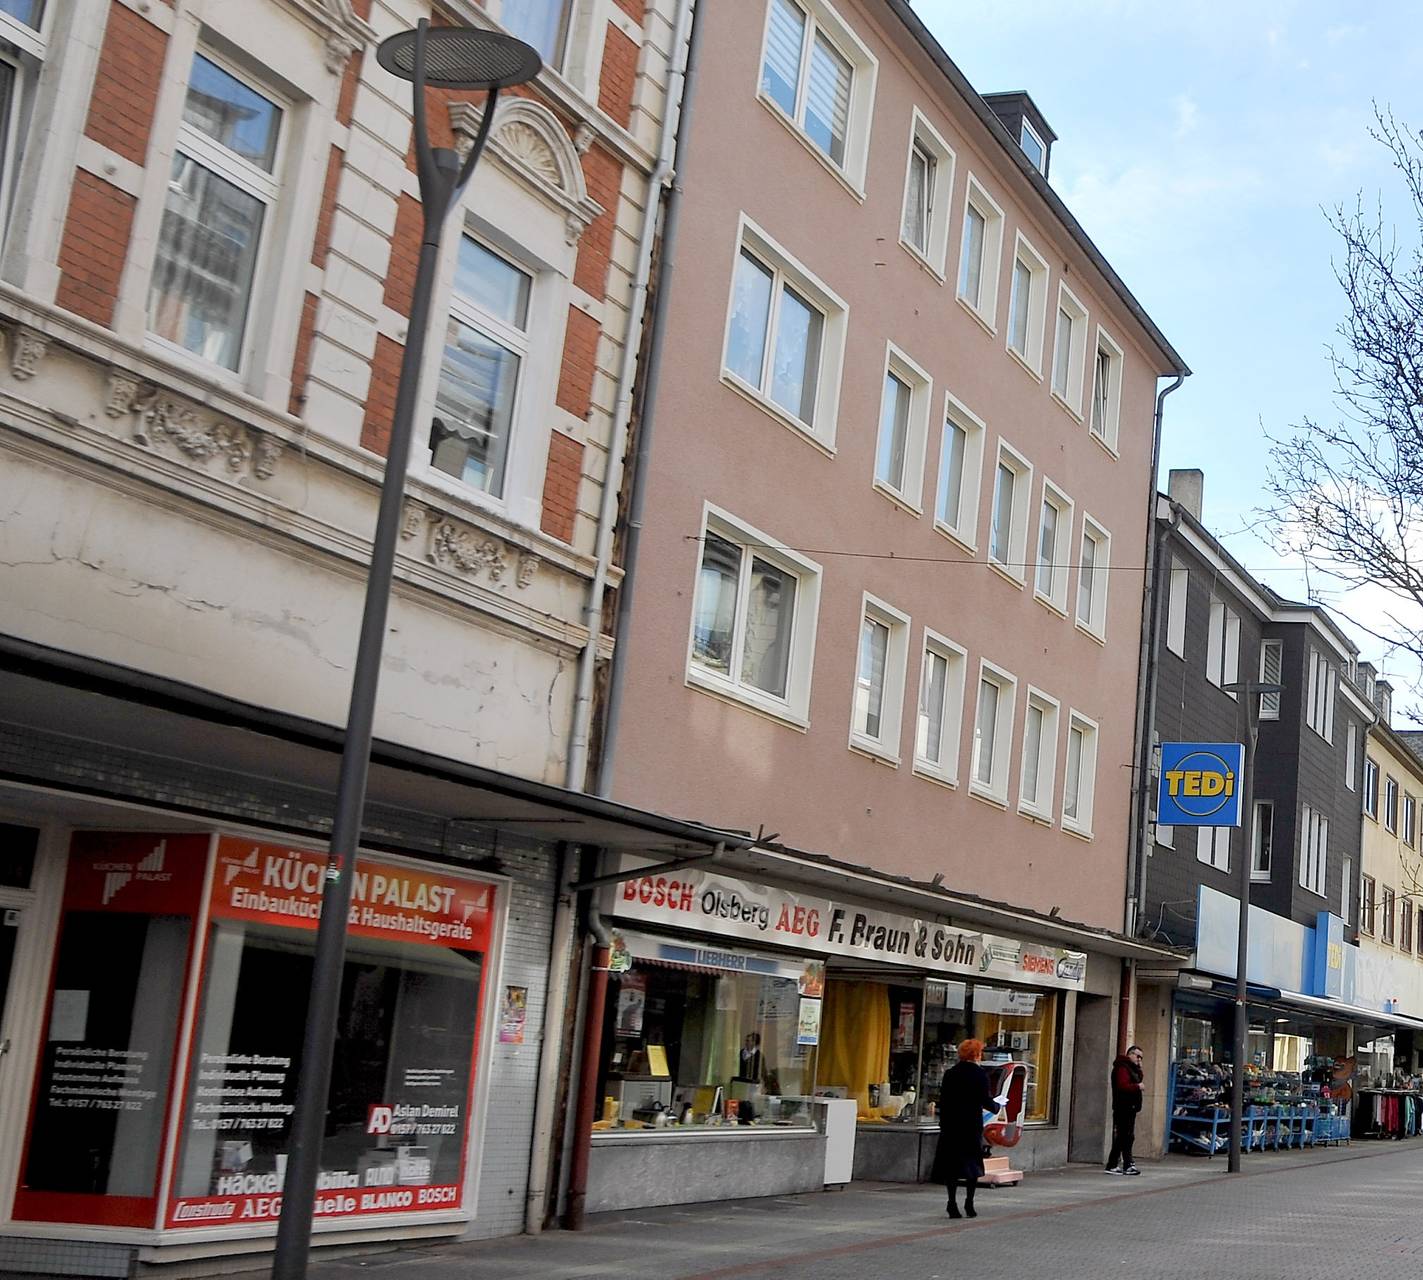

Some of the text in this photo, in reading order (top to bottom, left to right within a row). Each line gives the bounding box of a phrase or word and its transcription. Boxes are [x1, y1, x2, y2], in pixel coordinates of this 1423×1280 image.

[1165, 770, 1235, 796] TEDi
[262, 851, 456, 914] KÜCN PALAST
[360, 906, 473, 940] Haushaltsgeräte
[622, 875, 976, 967] BOSCH Olsberg AEG F. Braun & Sohn
[698, 950, 745, 969] LIEBHERR
[1023, 953, 1055, 975] SIEMENS
[393, 1103, 459, 1118] Aslan Demirel
[240, 1197, 283, 1219] AEG
[313, 1193, 357, 1214] iele
[360, 1190, 413, 1210] BLANCO
[417, 1186, 457, 1203] BOSCH
